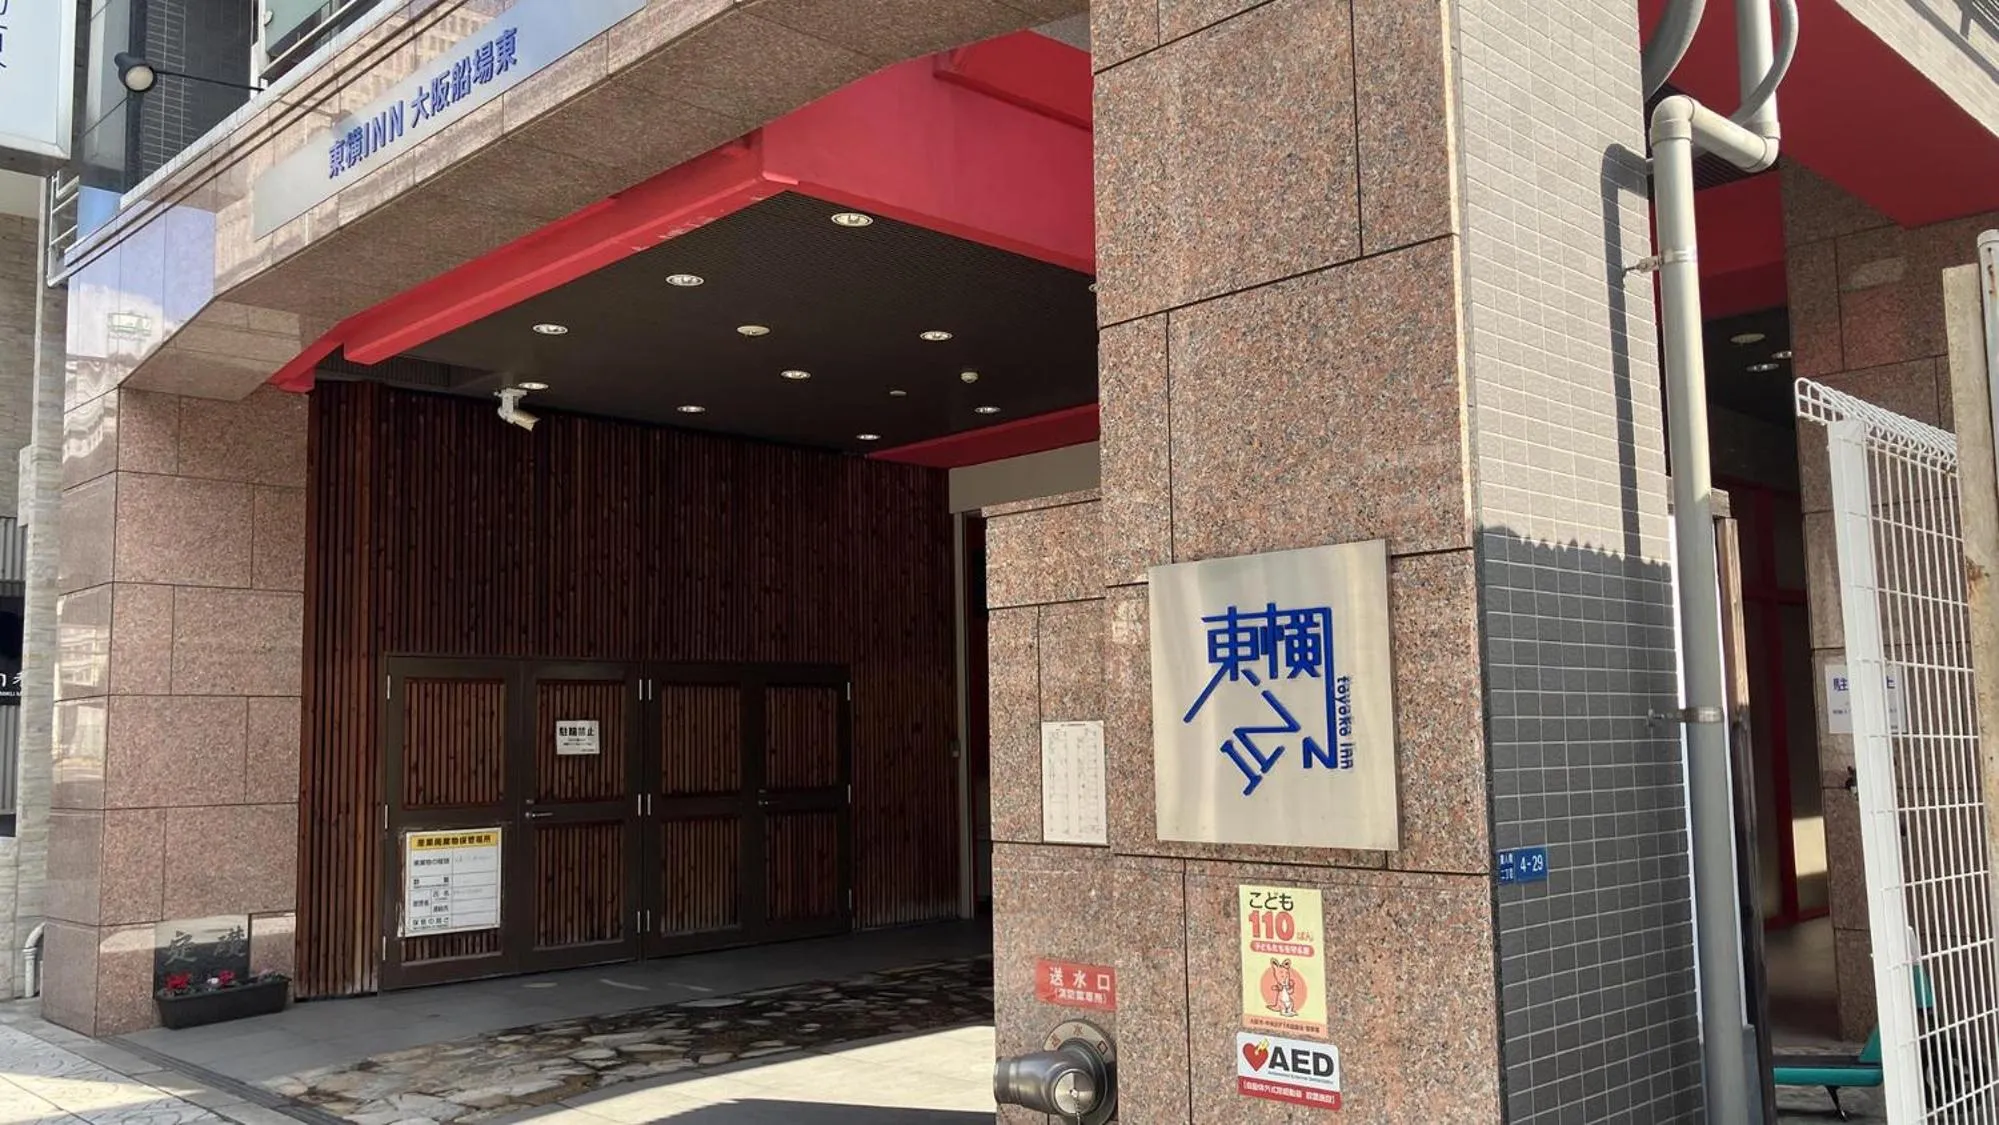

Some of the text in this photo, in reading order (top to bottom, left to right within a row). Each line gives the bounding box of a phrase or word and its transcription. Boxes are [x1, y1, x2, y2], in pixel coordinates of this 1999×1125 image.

[329, 27, 518, 179] 東横INN 大阪船場東
[1335, 676, 1353, 737] toyoko
[1520, 854, 1544, 872] 4-29
[1249, 892, 1294, 912] こども
[1248, 910, 1295, 941] 110
[1049, 967, 1111, 992] 送水口
[1268, 1046, 1334, 1077] AED
